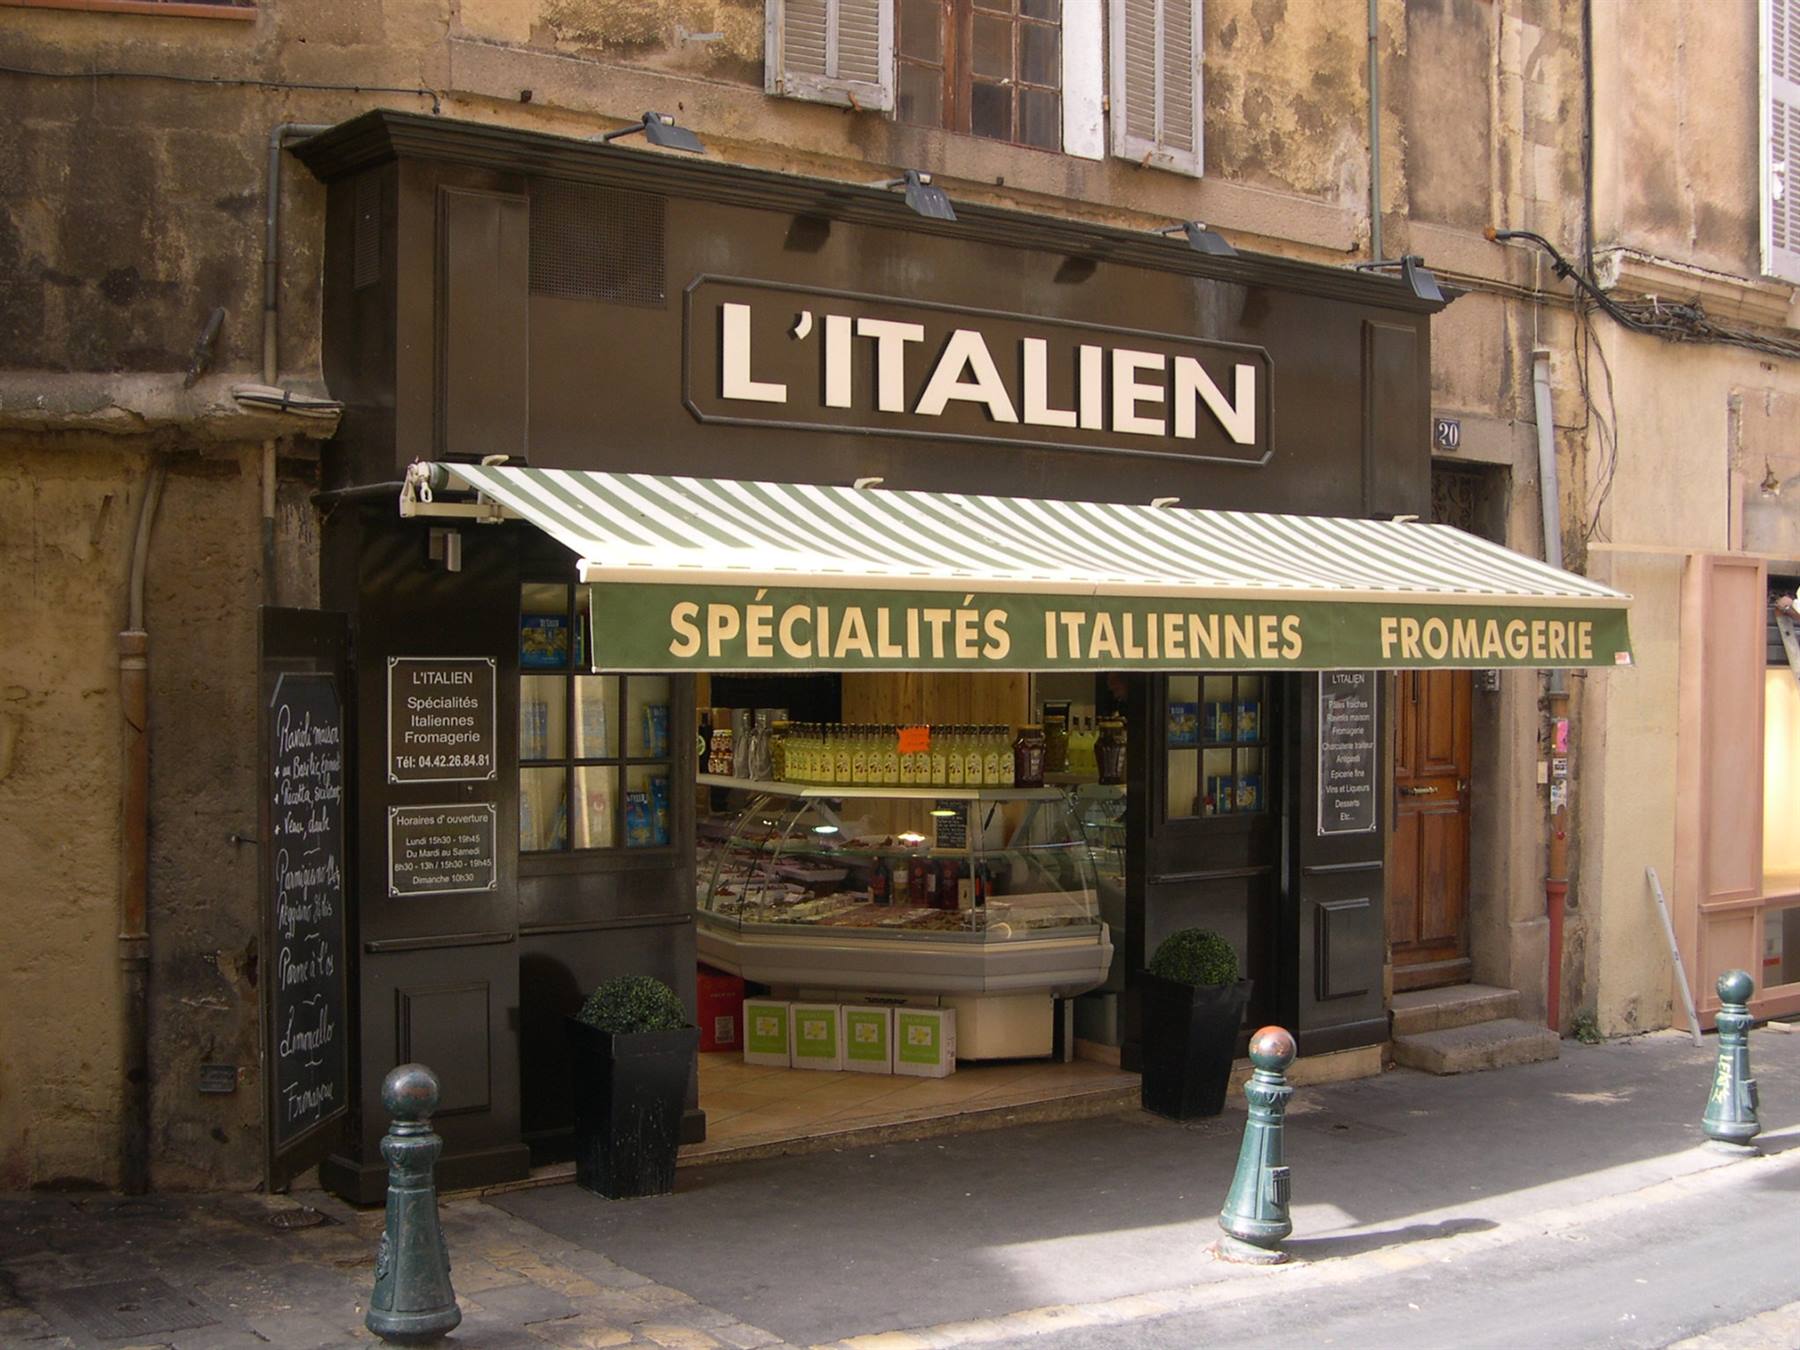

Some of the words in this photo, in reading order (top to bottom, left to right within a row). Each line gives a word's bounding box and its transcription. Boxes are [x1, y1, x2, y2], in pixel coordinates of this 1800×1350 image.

[721, 302, 1256, 446] L'ITALIEN
[1438, 422, 1458, 446] 20
[668, 588, 1011, 660] SPÉCIALITÉS
[1045, 611, 1301, 660] ITALIENNES
[1380, 617, 1593, 660] FROMAGERIE
[412, 671, 473, 684] L'ITALIEN
[407, 696, 479, 711] Spécialités
[411, 714, 474, 727] Italiennes
[405, 731, 480, 745] Fromagerie
[396, 755, 416, 768] Tél:
[418, 754, 490, 768] 04.42.26.84.81
[396, 815, 434, 826] Horaires
[446, 814, 489, 824] ouverture
[406, 837, 427, 846] Lundi
[429, 836, 451, 845] 15h30
[406, 850, 418, 858] Du
[419, 849, 440, 857] Mardi
[452, 847, 480, 856] Samedi
[412, 875, 450, 885] Dimanche
